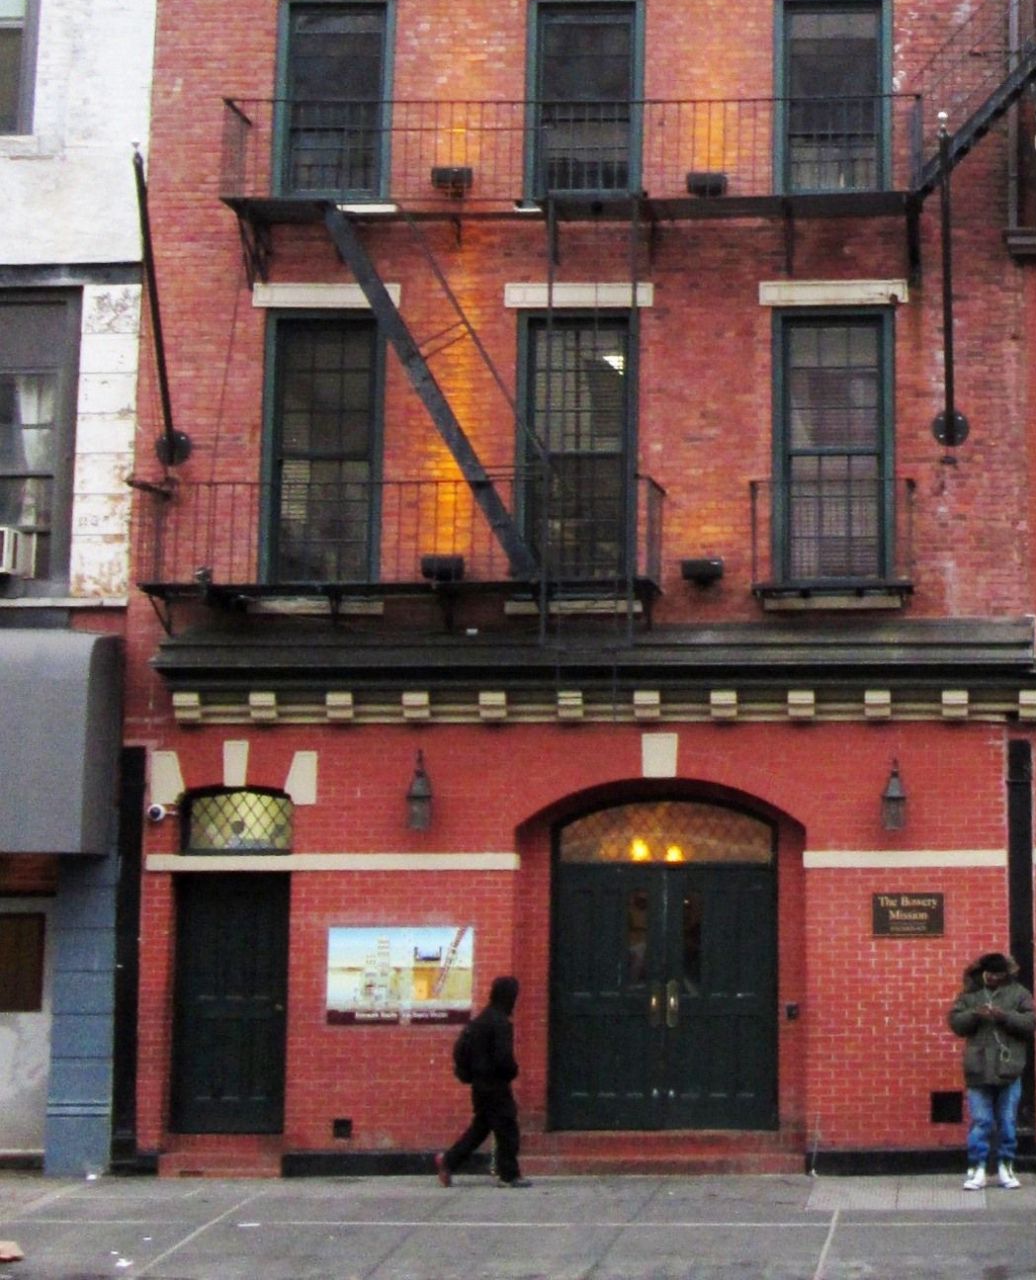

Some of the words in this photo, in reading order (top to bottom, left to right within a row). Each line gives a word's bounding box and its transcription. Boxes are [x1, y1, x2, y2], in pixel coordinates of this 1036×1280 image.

[878, 895, 898, 907] The
[900, 895, 938, 909] Bowery
[889, 909, 929, 920] Mission
